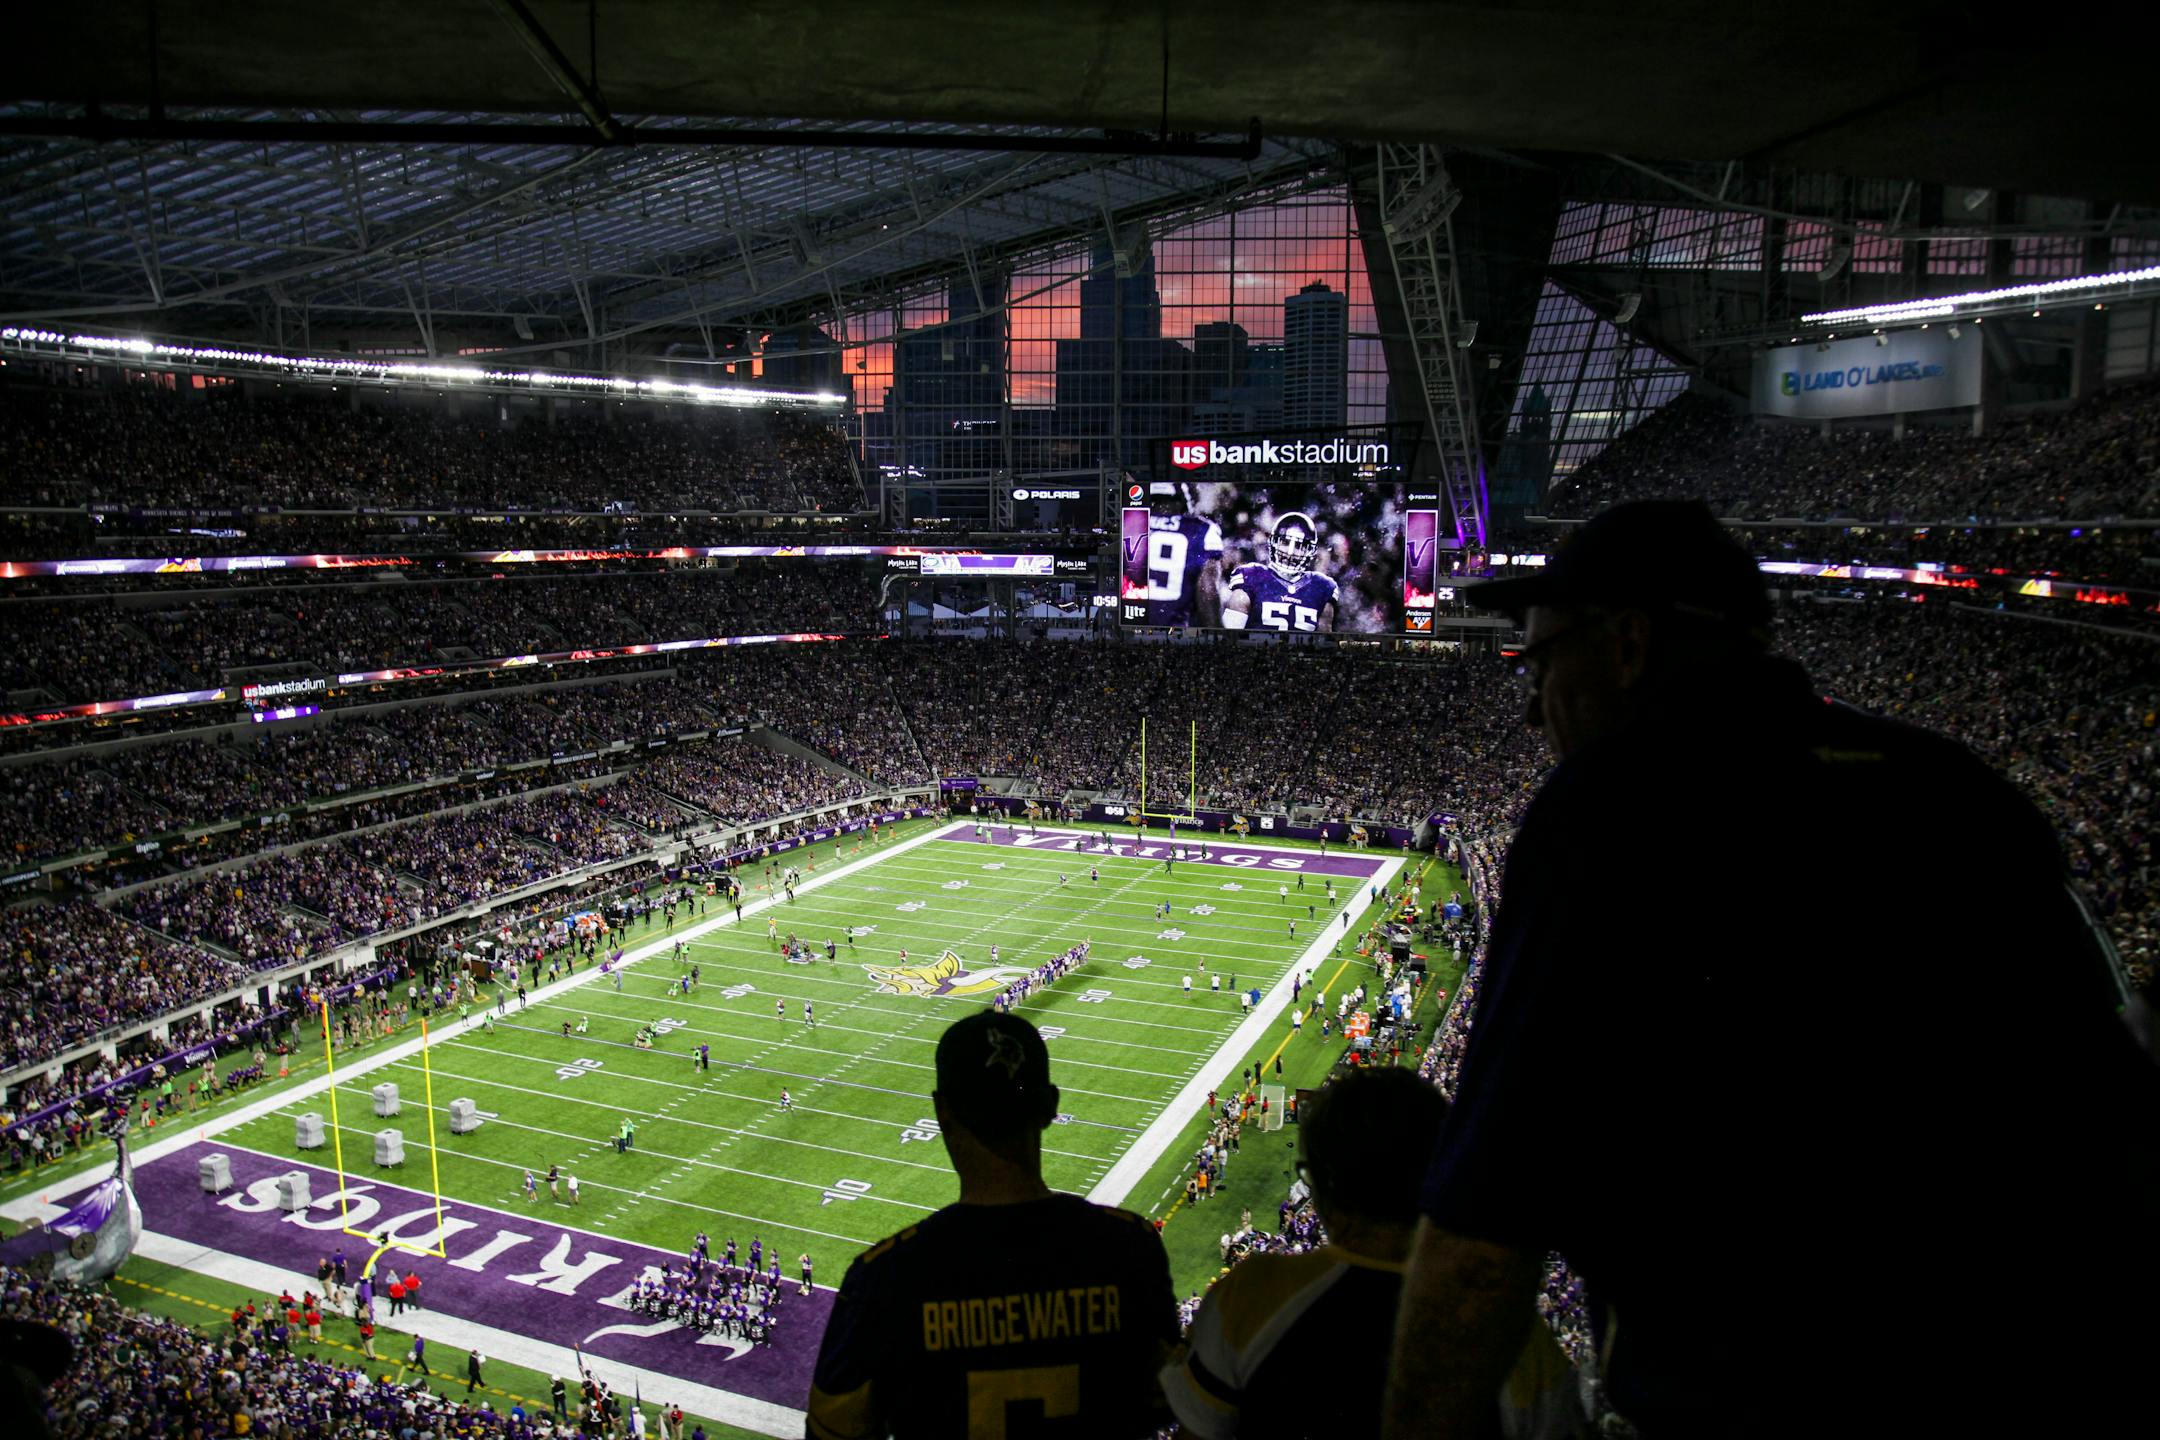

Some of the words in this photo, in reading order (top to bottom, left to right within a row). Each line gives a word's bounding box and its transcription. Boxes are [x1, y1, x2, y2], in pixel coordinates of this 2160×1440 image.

[1804, 370, 1844, 391] LAND
[1031, 491, 1080, 499] POLARIS
[1094, 596, 1118, 607] 10:58
[1125, 605, 1146, 619] Lite
[1262, 601, 1318, 632] 55
[1076, 989, 1112, 1004] 50
[555, 1058, 604, 1077] 20
[900, 1118, 941, 1142] 20
[822, 1178, 873, 1201] 10
[921, 1284, 1121, 1353] BRIDGEWATER
